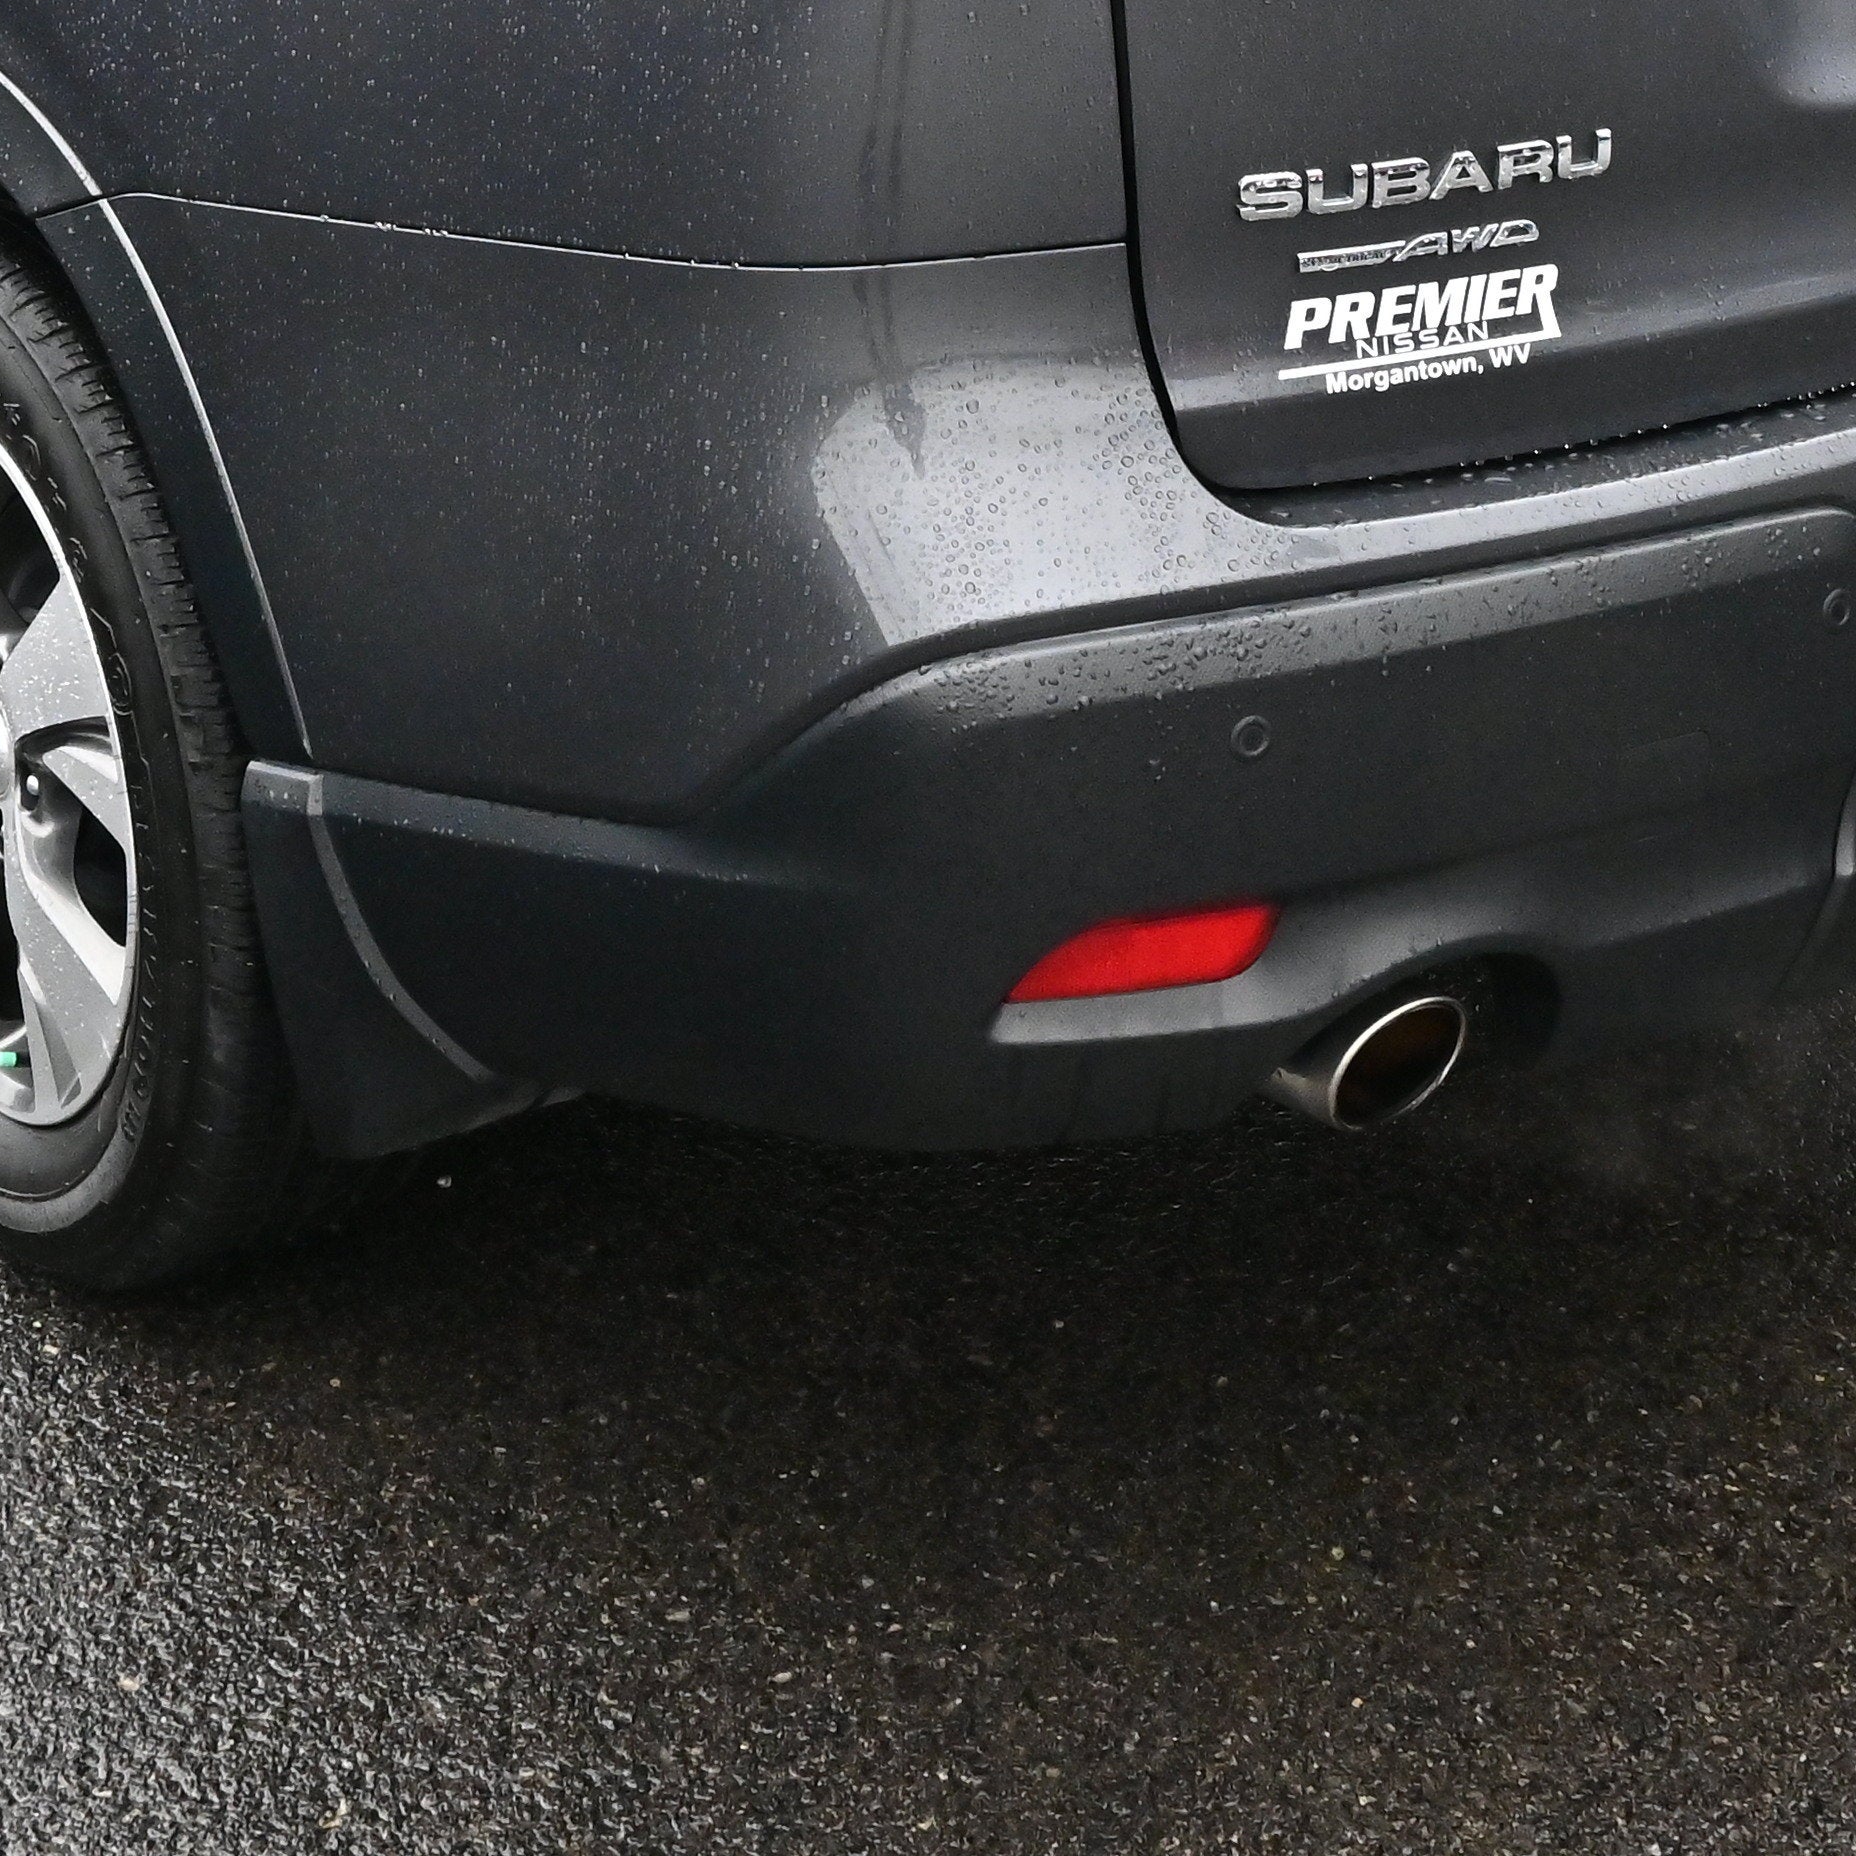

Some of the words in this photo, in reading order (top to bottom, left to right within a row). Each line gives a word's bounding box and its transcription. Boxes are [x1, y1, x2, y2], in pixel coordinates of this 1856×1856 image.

[1236, 128, 1612, 222] SUBARU
[1392, 218, 1540, 262] AWD
[1283, 263, 1561, 350] PREMIER
[1356, 321, 1489, 359] NISSAN
[1325, 353, 1484, 395] Morgantown,
[1491, 344, 1532, 366] WV
